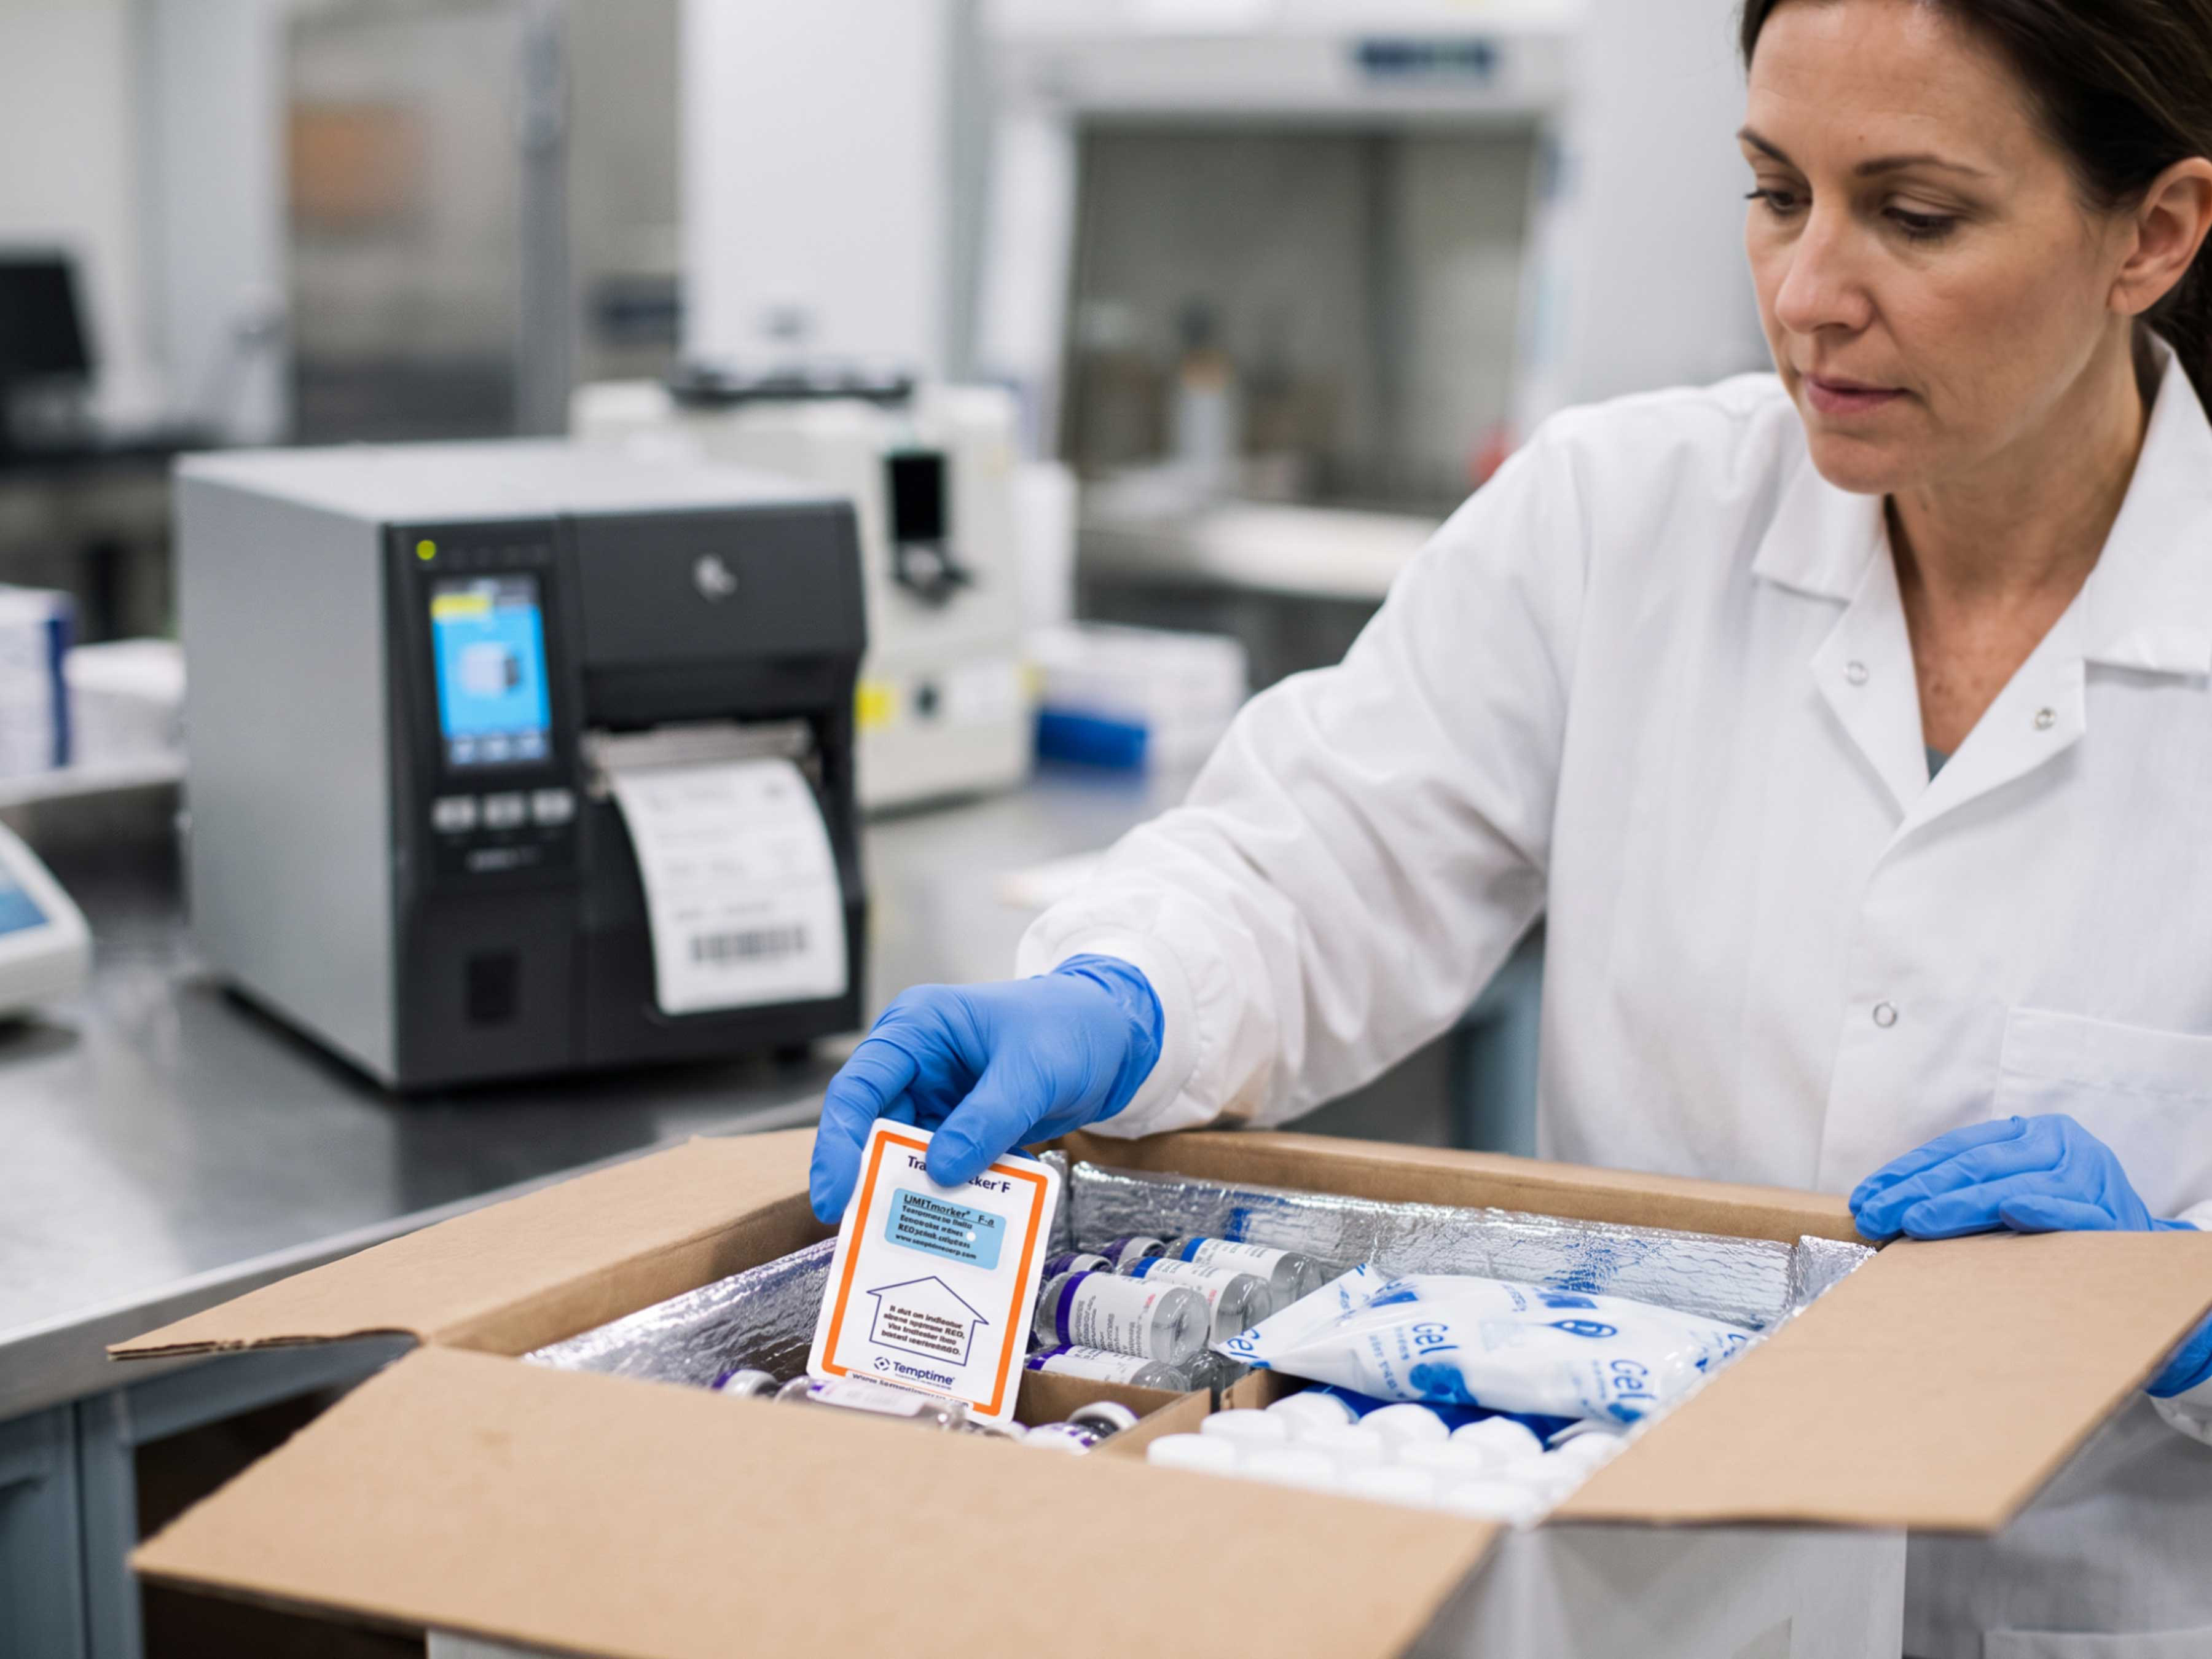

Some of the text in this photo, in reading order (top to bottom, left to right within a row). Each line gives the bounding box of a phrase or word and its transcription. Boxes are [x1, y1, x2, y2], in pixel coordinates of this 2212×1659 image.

[1001, 1181, 1011, 1193] F
[1413, 1322, 1459, 1355] Gel
[893, 1361, 954, 1386] Temptime
[1610, 1359, 1657, 1401] Gel
